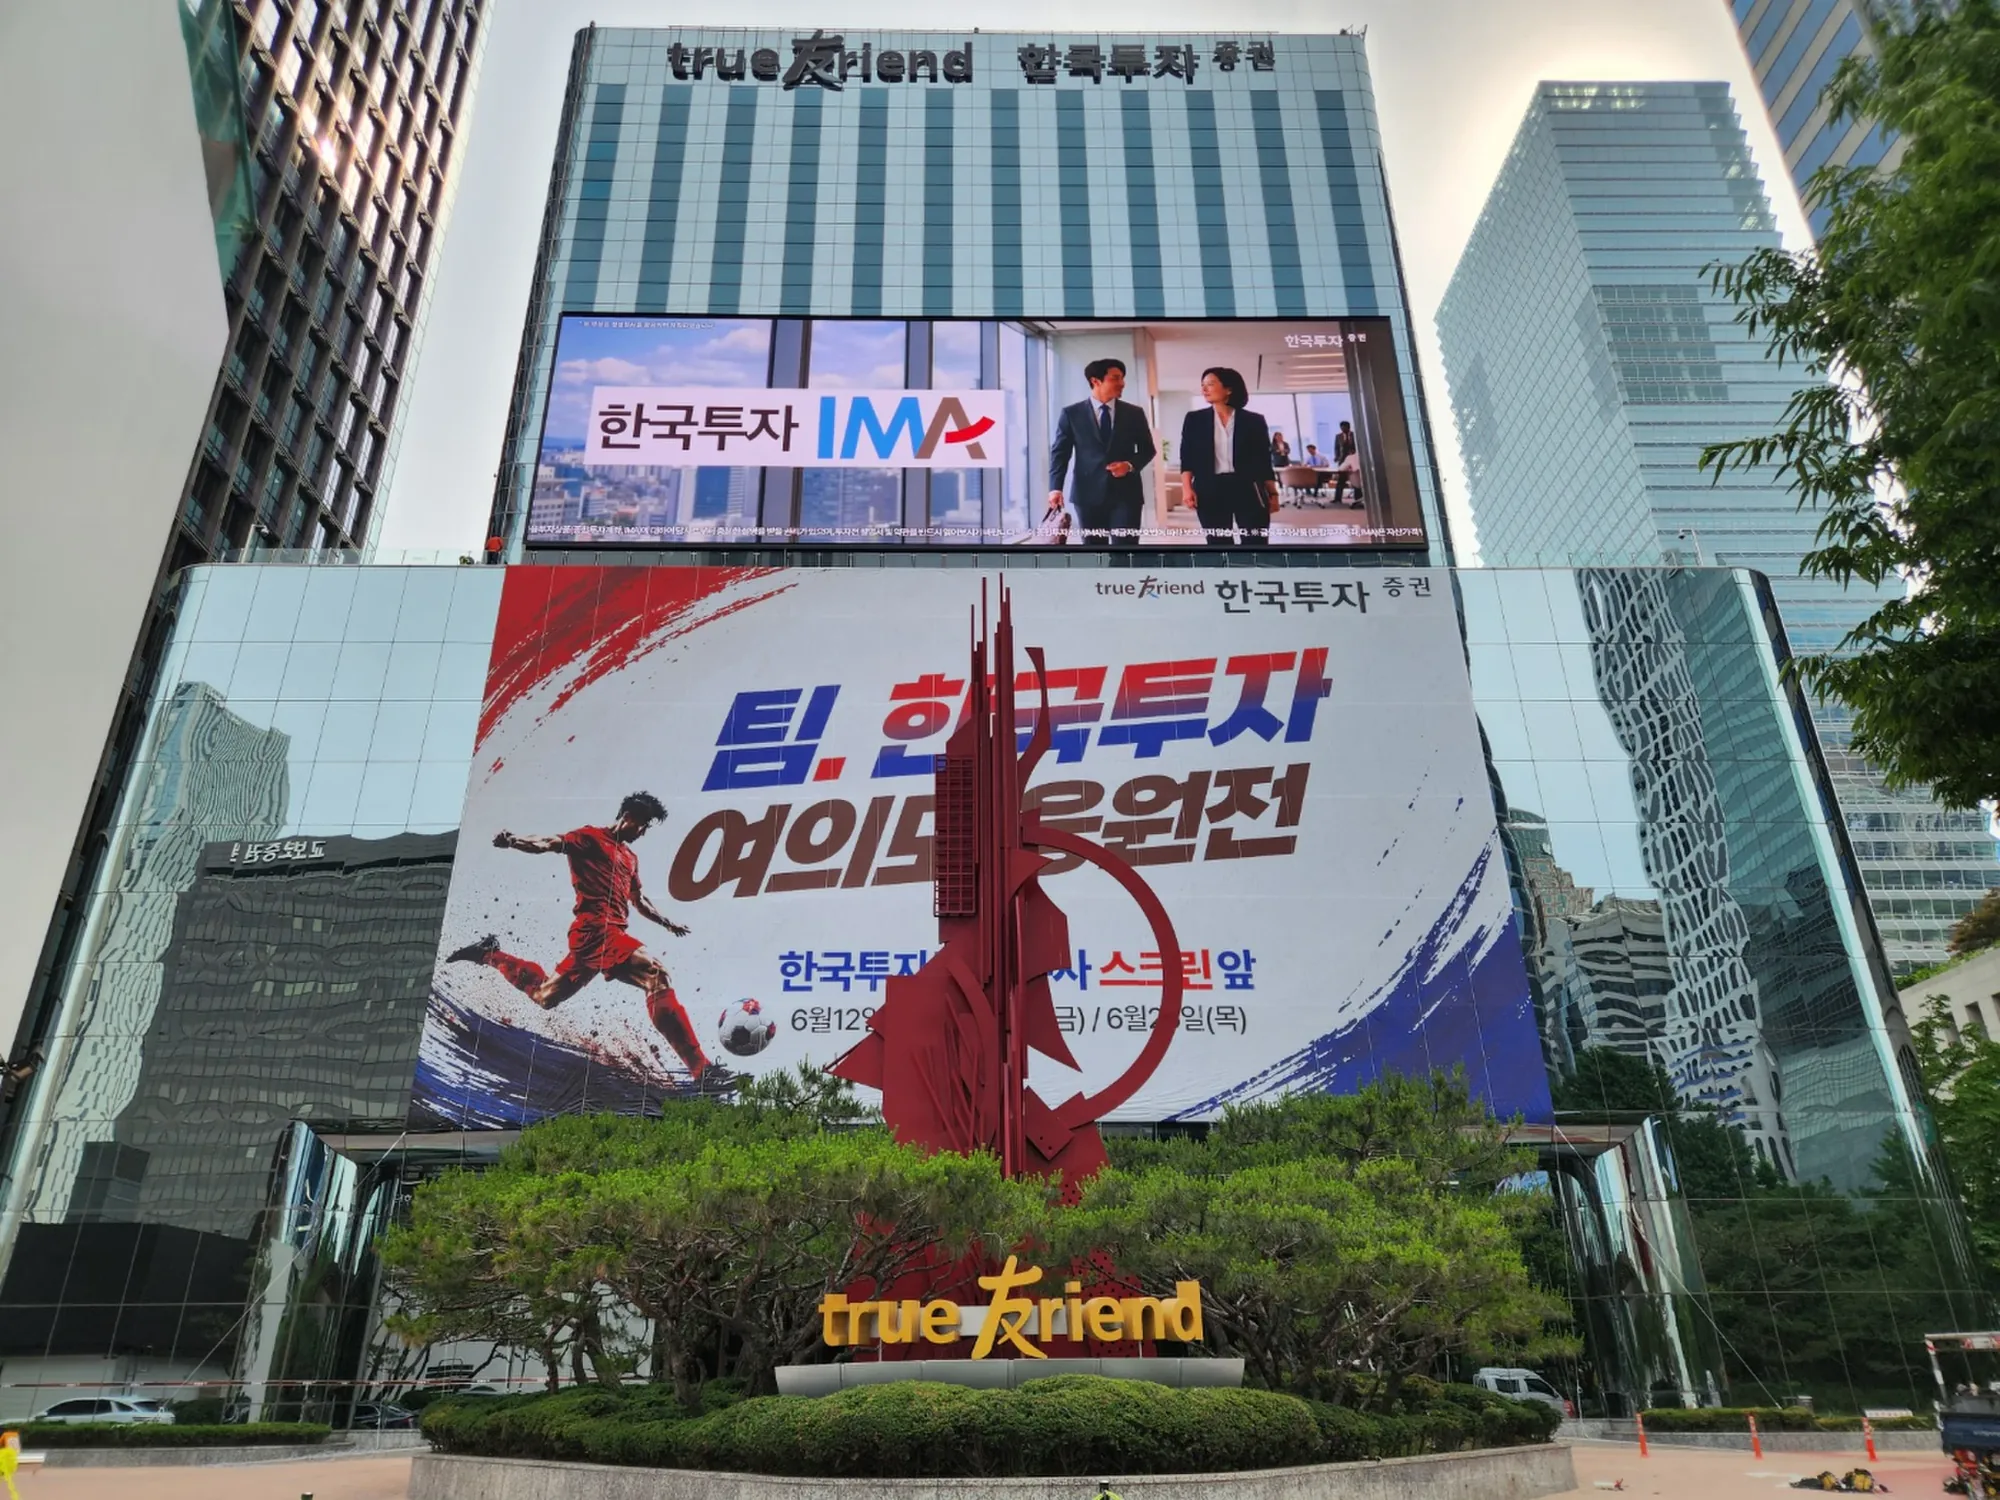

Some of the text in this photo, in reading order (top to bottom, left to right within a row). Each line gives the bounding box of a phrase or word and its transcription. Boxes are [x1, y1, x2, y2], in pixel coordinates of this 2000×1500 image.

[1017, 43, 1200, 85] 한국투자
[1212, 40, 1275, 72] 증권
[1284, 333, 1343, 348] 한국투자
[598, 396, 995, 460] 한국투자 IMA
[1215, 580, 1370, 614] 한국투자
[1382, 576, 1432, 598] 증권
[702, 684, 846, 791] 팀.
[1107, 1004, 1247, 1034] 6월2일(목)
